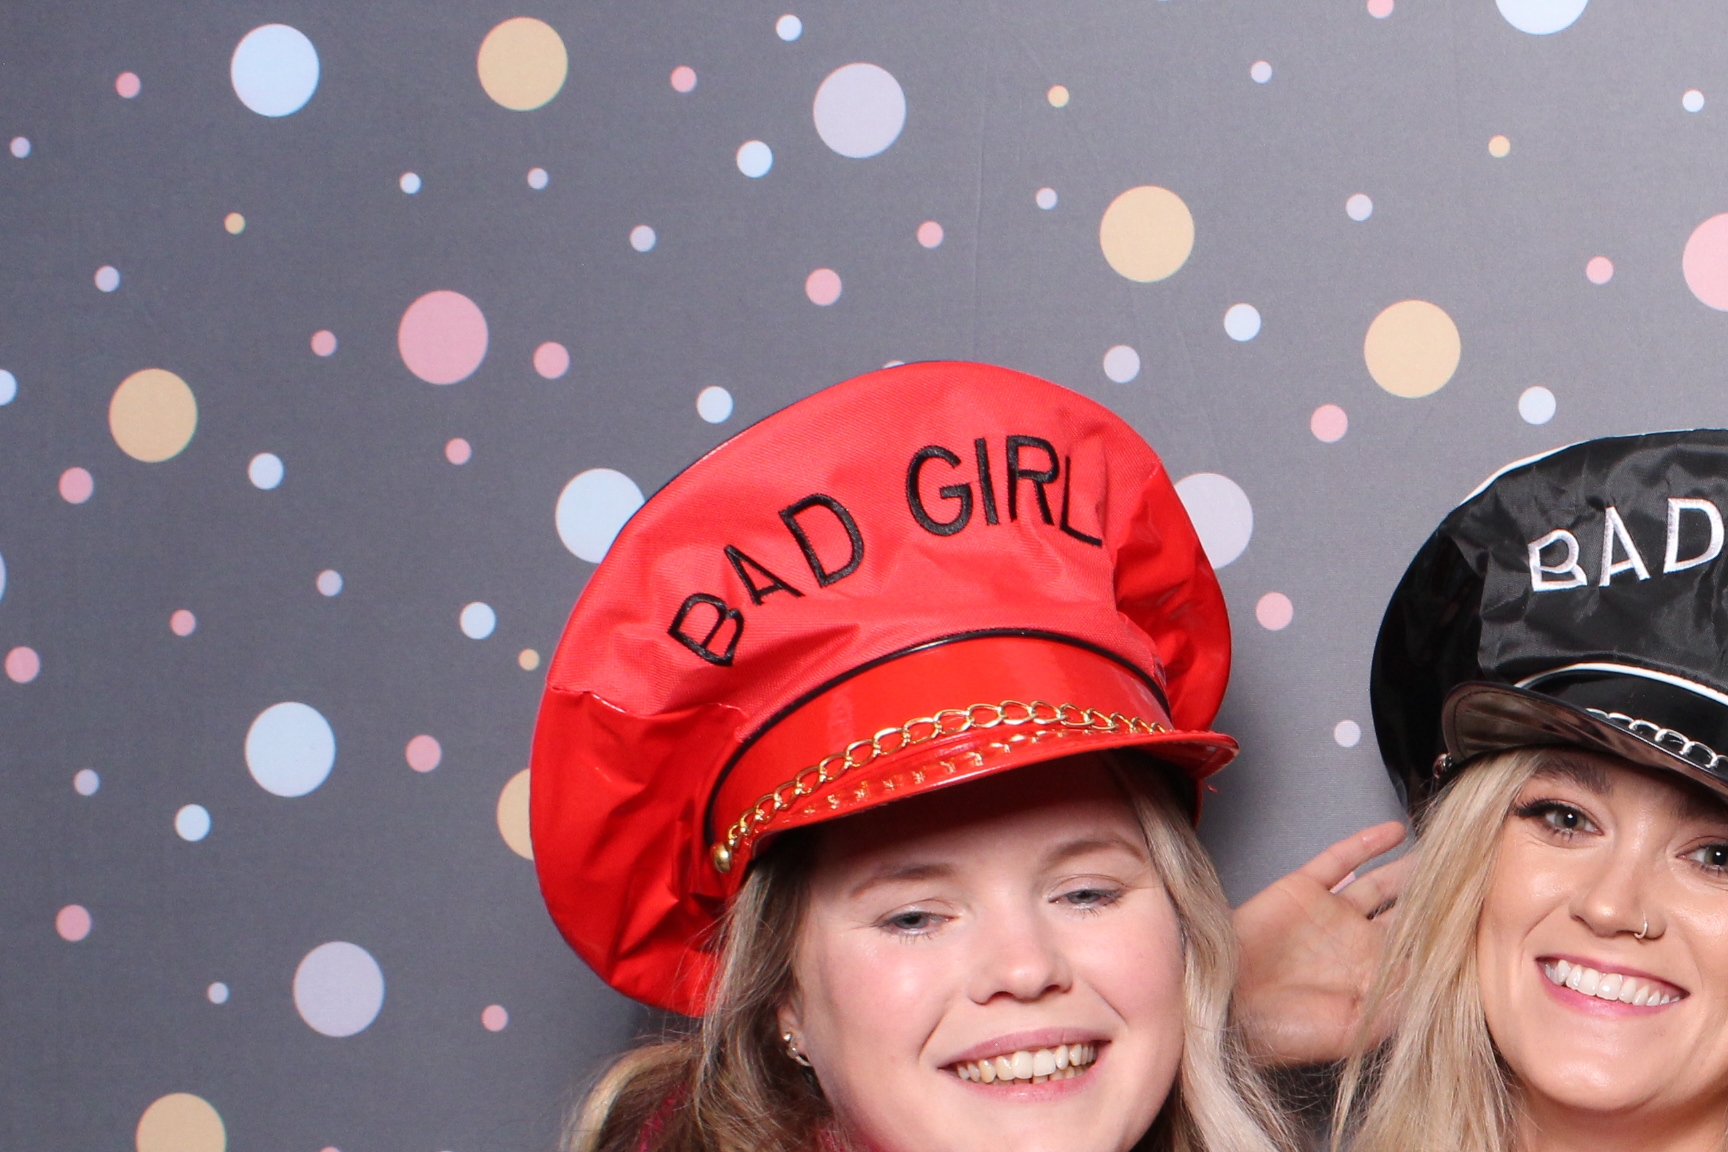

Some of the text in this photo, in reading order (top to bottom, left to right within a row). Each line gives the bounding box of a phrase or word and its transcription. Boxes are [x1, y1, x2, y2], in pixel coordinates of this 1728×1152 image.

[667, 434, 1103, 666] BAD GIRL
[1527, 497, 1725, 592] BAD
